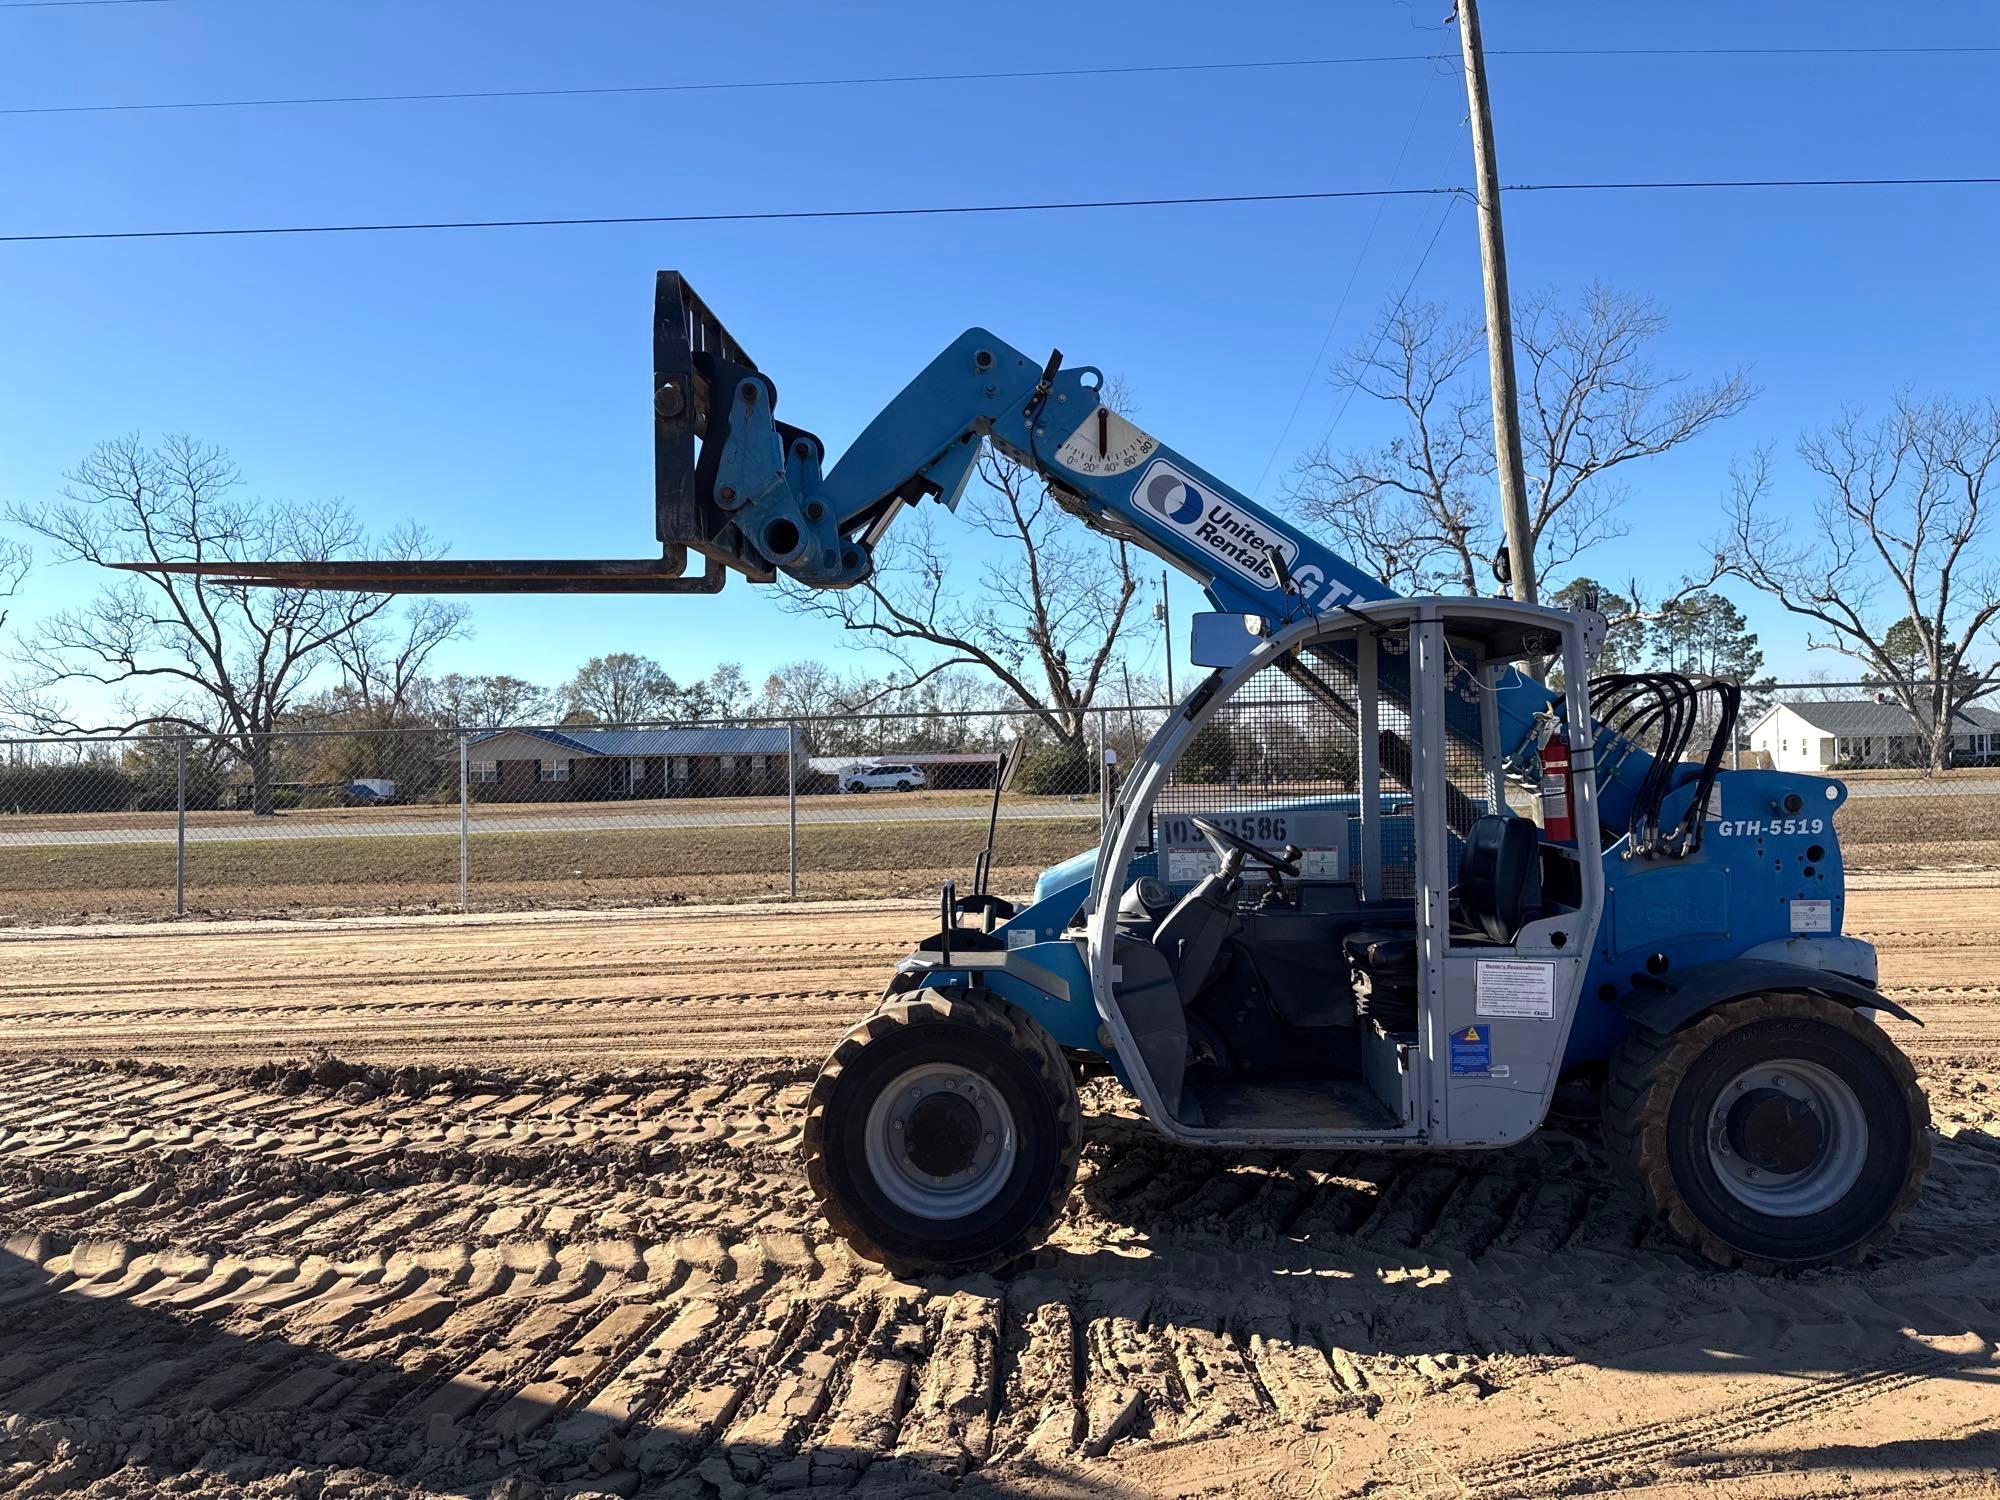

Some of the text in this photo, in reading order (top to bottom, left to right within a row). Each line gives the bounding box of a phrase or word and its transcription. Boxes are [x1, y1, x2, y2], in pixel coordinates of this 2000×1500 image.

[1104, 462, 1119, 472] 40°
[1123, 453, 1138, 467] 60°
[1140, 437, 1153, 454] 80°
[1195, 522, 1275, 580] Rentals
[1208, 505, 1283, 557] United
[1719, 818, 1824, 836] GTH-5519
